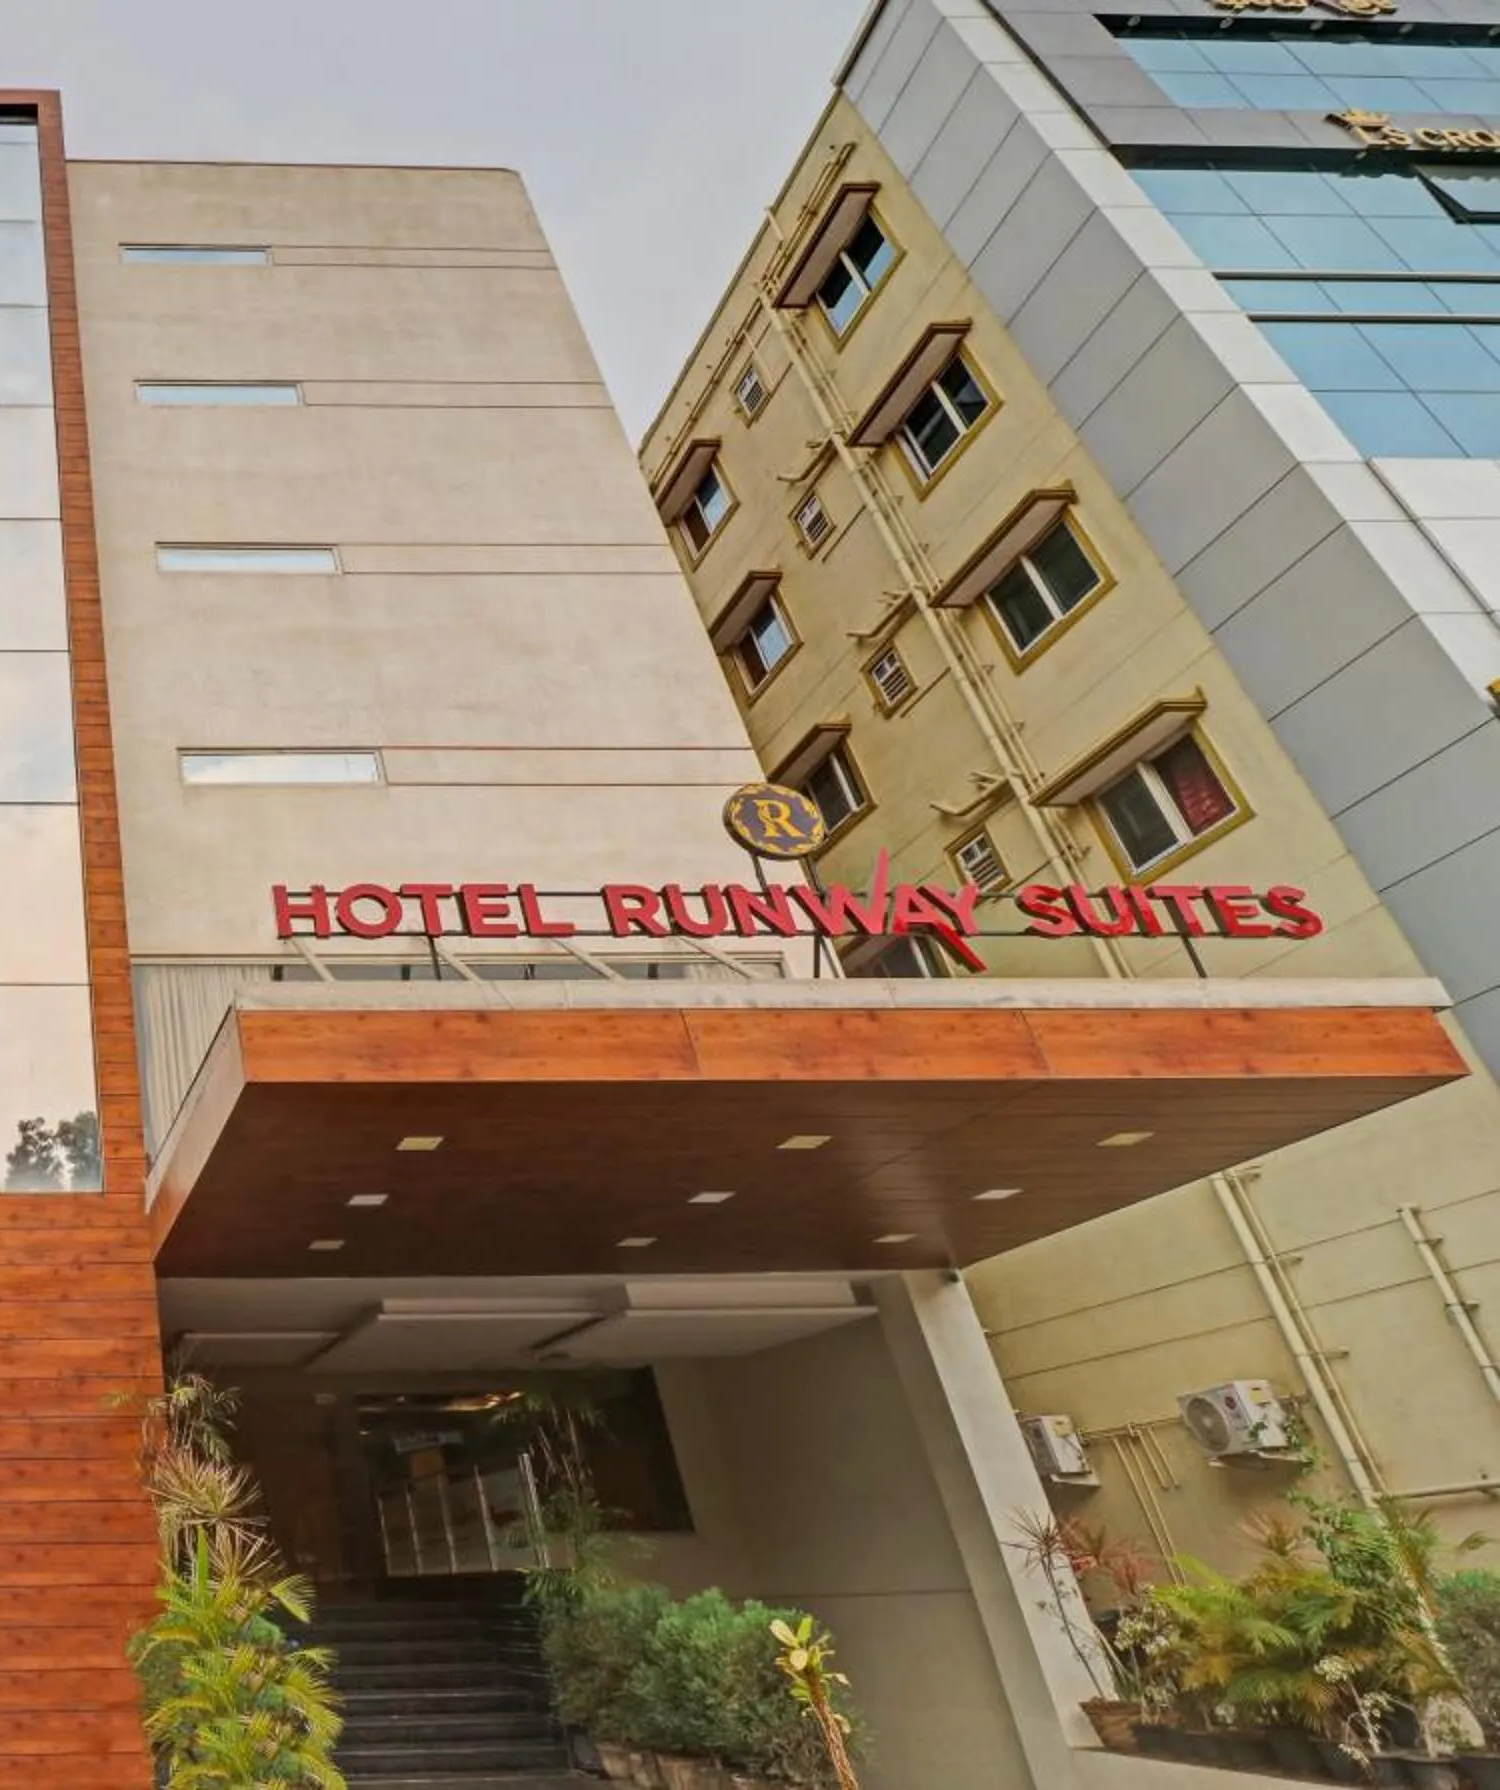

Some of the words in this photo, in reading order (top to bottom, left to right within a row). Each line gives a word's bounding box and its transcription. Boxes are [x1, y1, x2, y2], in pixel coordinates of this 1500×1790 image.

[1415, 127, 1500, 149] CRO
[754, 800, 805, 837] R
[272, 883, 576, 939] HOTEL
[601, 846, 987, 973] RUNWAY
[1015, 884, 1325, 940] SUITES
